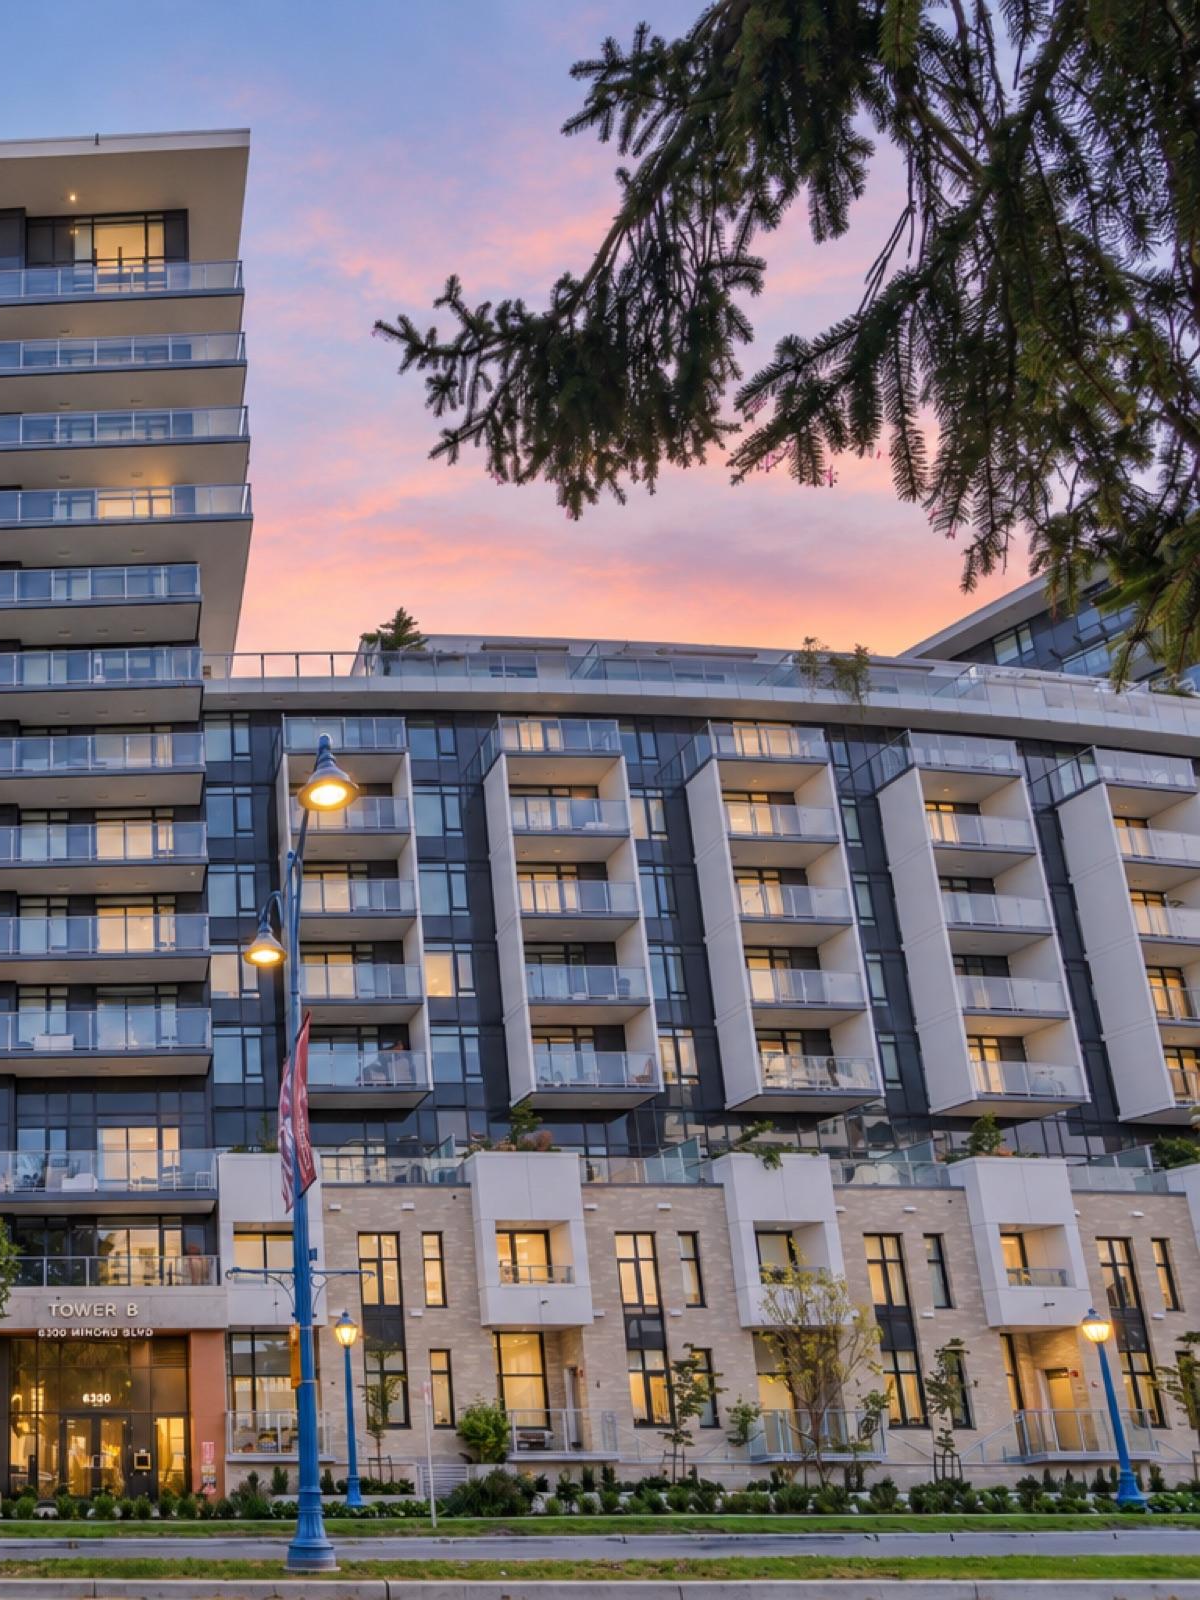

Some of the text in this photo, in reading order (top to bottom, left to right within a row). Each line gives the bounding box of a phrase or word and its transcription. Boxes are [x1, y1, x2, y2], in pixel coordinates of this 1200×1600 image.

[48, 1302, 139, 1317] TOWER B
[38, 1328, 154, 1337] 6300 MINORU BLVD
[83, 1393, 111, 1403] 6300
